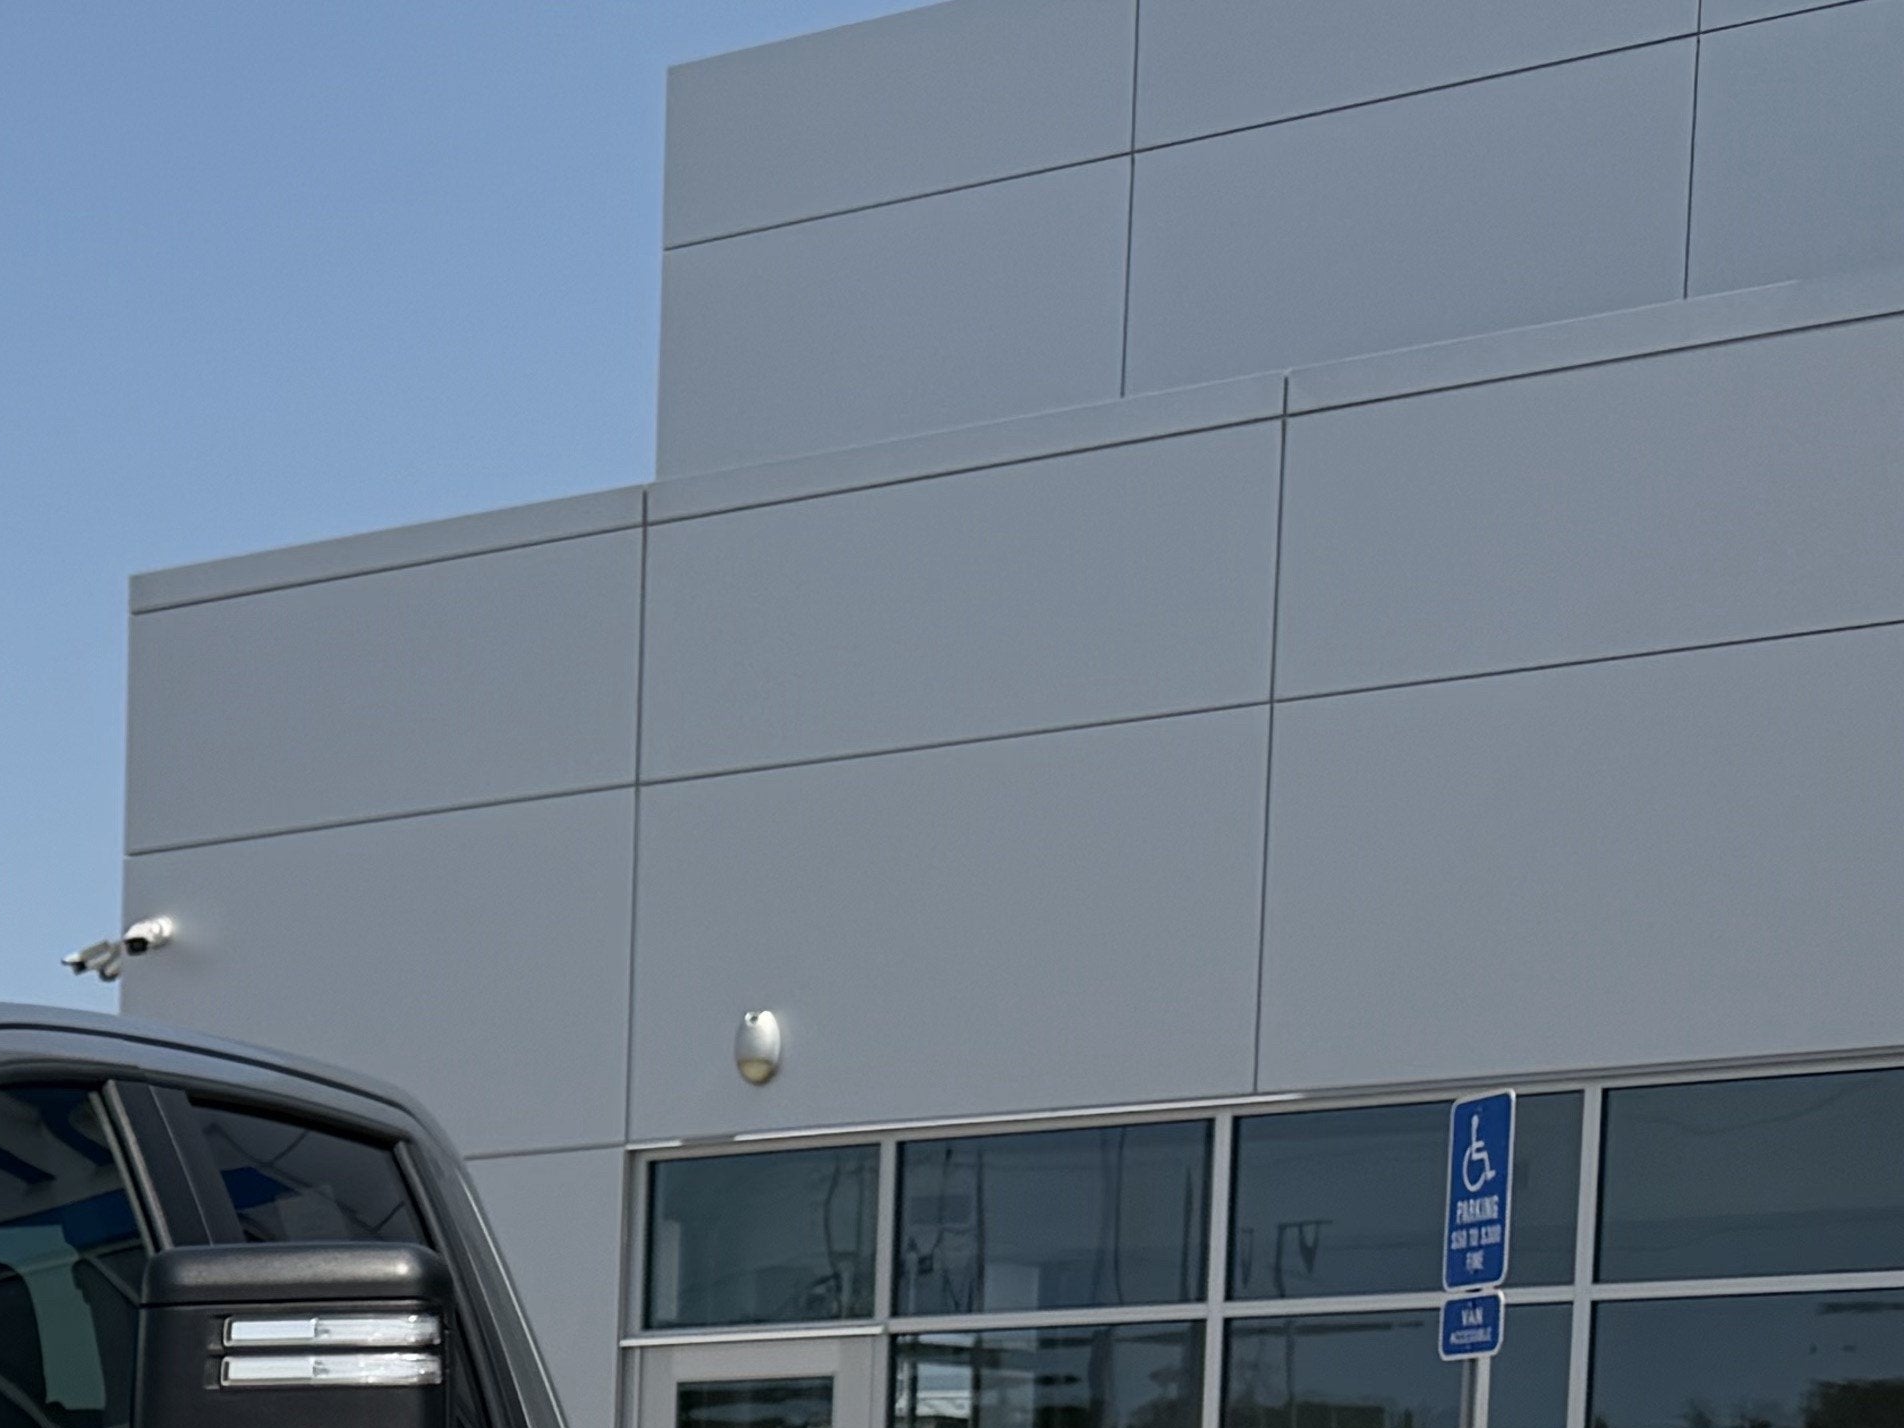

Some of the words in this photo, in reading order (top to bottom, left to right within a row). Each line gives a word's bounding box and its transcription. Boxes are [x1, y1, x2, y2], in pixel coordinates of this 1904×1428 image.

[1456, 1195, 1499, 1223] PARKING
[1469, 1227, 1480, 1247] TO
[1461, 1307, 1483, 1326] VAN
